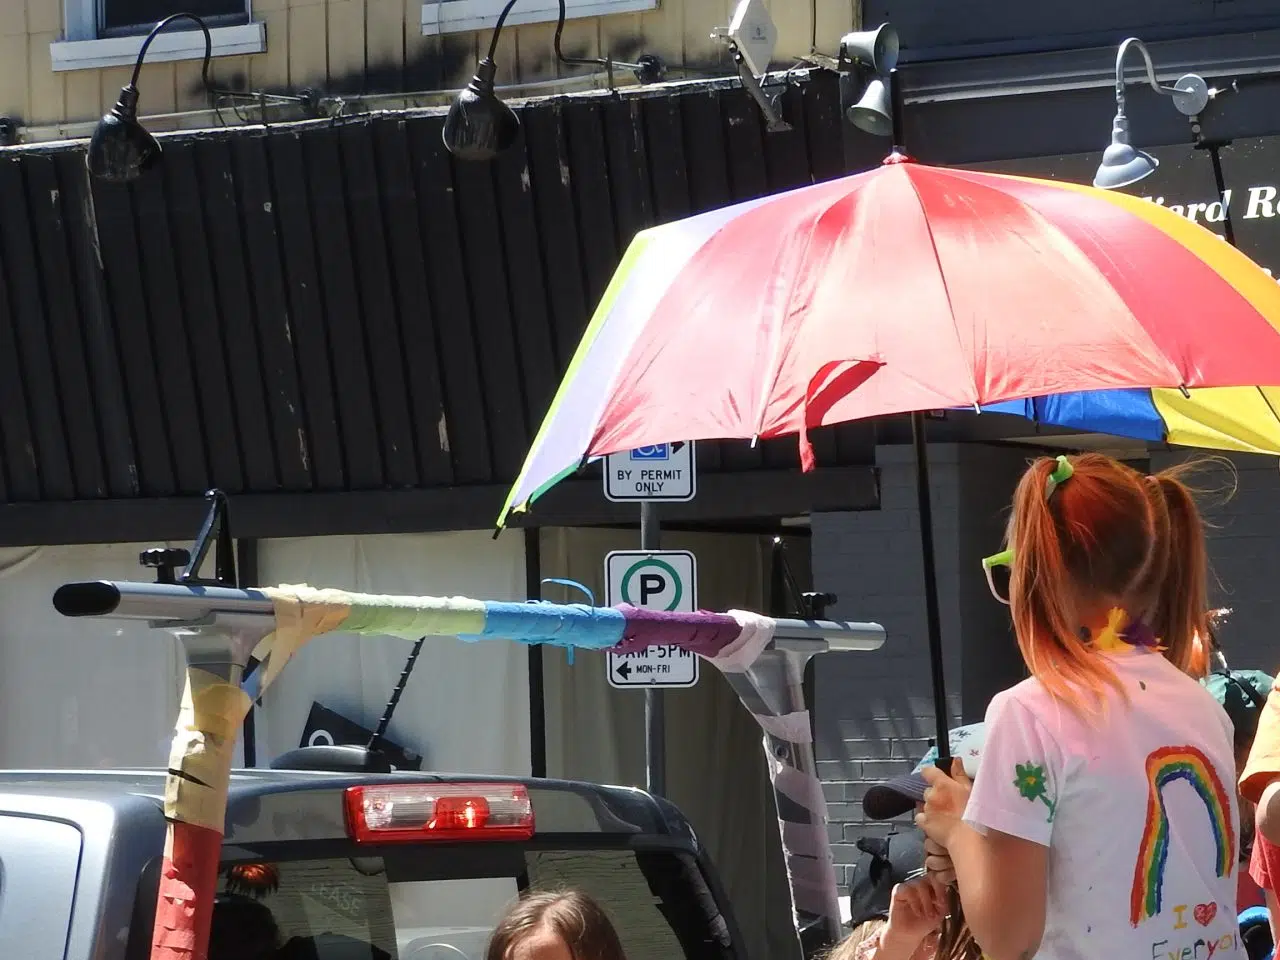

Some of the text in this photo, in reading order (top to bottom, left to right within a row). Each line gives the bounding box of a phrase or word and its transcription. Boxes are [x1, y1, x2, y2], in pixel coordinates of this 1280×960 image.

[617, 470, 682, 480] BY PERMIT
[635, 482, 665, 492] ONLY
[640, 574, 666, 606] P
[636, 664, 671, 674] MON-FRI
